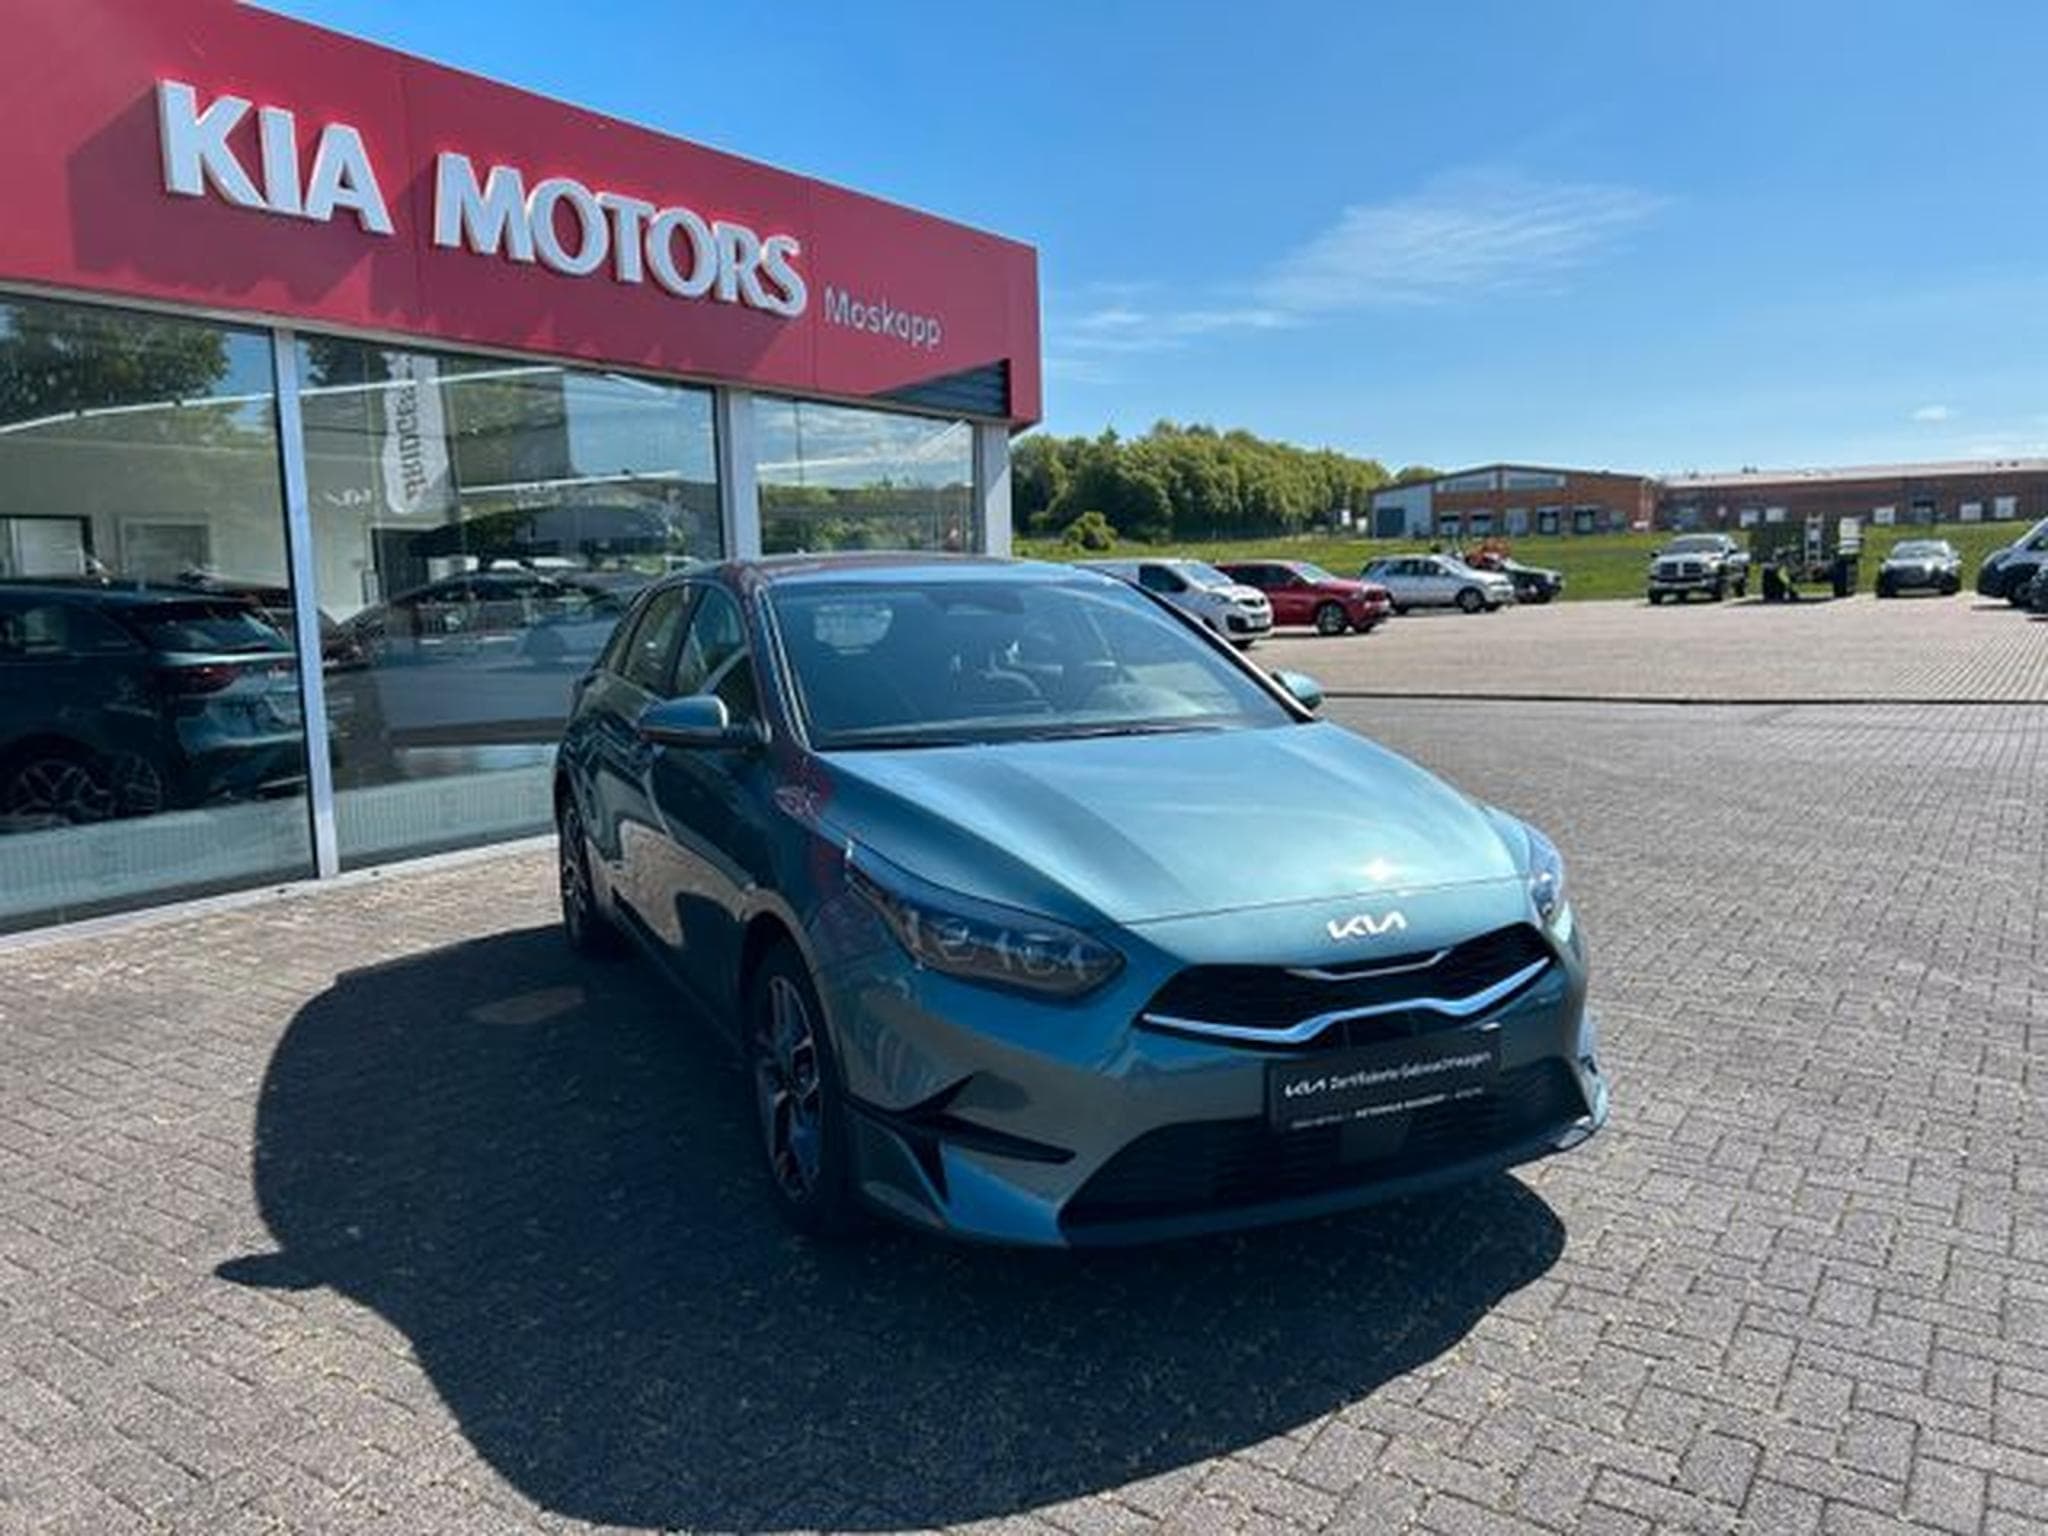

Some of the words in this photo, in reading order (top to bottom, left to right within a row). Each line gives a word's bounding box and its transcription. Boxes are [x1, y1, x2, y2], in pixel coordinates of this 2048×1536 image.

[157, 78, 395, 236] KIA
[434, 151, 807, 317] MOTORS
[1326, 910, 1406, 939] KIA
